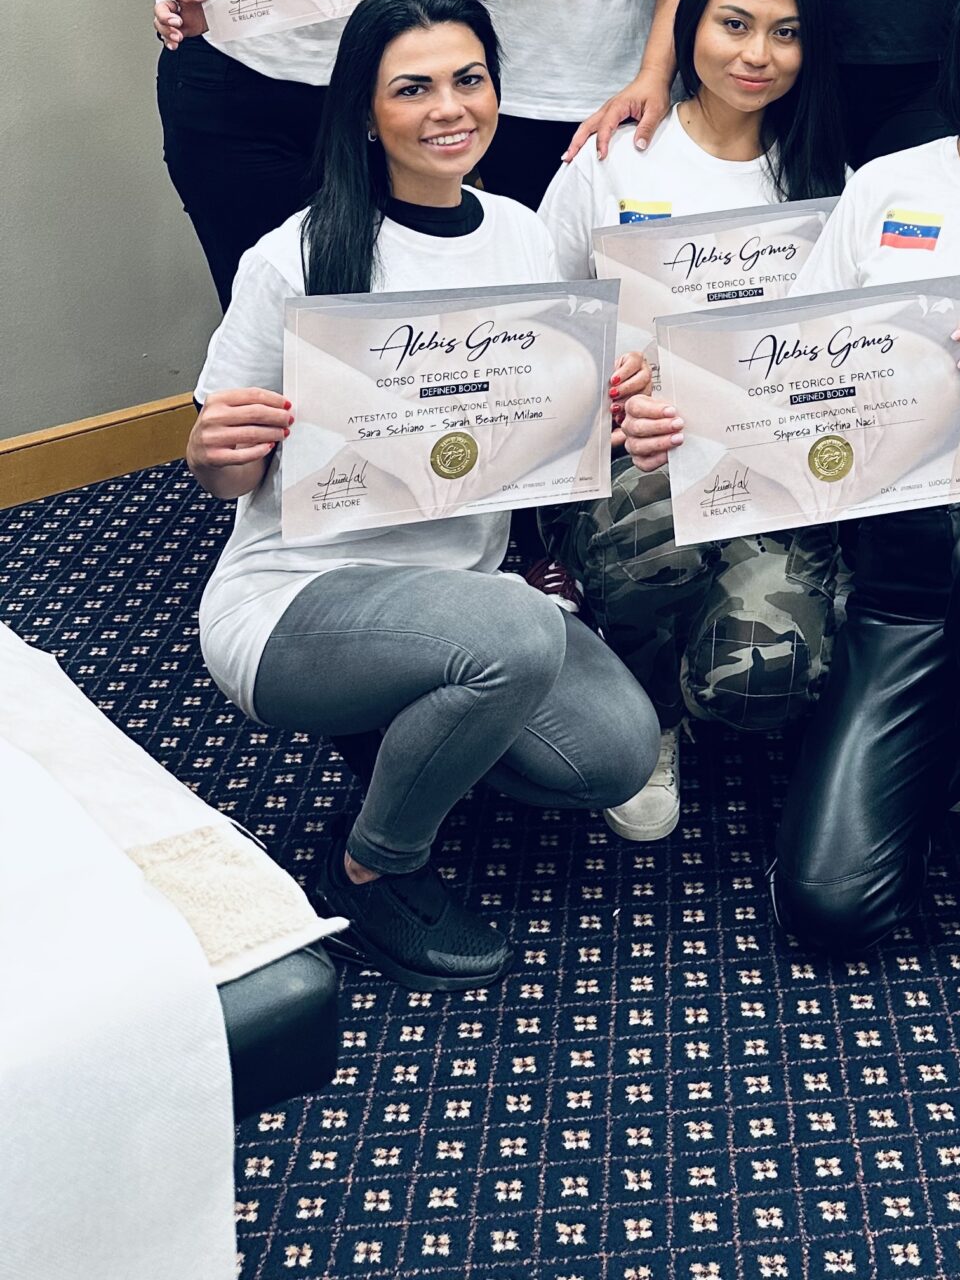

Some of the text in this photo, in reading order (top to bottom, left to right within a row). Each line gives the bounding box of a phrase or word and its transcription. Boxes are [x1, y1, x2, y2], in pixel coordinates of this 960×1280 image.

[663, 236, 796, 279] Alebis Gomez
[670, 272, 797, 294] CORSO TEORICO E PRATICO
[708, 291, 738, 301] DEFINED
[370, 318, 534, 370] Alebis Gomez
[738, 325, 893, 379] Alebis Gomez
[376, 364, 531, 389] CORSO TEORICO E PRATICO
[747, 368, 894, 398] CORSO TEORICO E PRATICO
[422, 385, 457, 397] DEFINED
[791, 391, 826, 404] DEFINED
[348, 396, 541, 425] ATTESTATO DI PARTECIPAZIONE RILASCIATO
[725, 399, 908, 433] ATTESTATO DI PARTECIPAZIONE RILASCIATO
[321, 498, 360, 511] RELATORE
[709, 504, 746, 517] RELATORE
